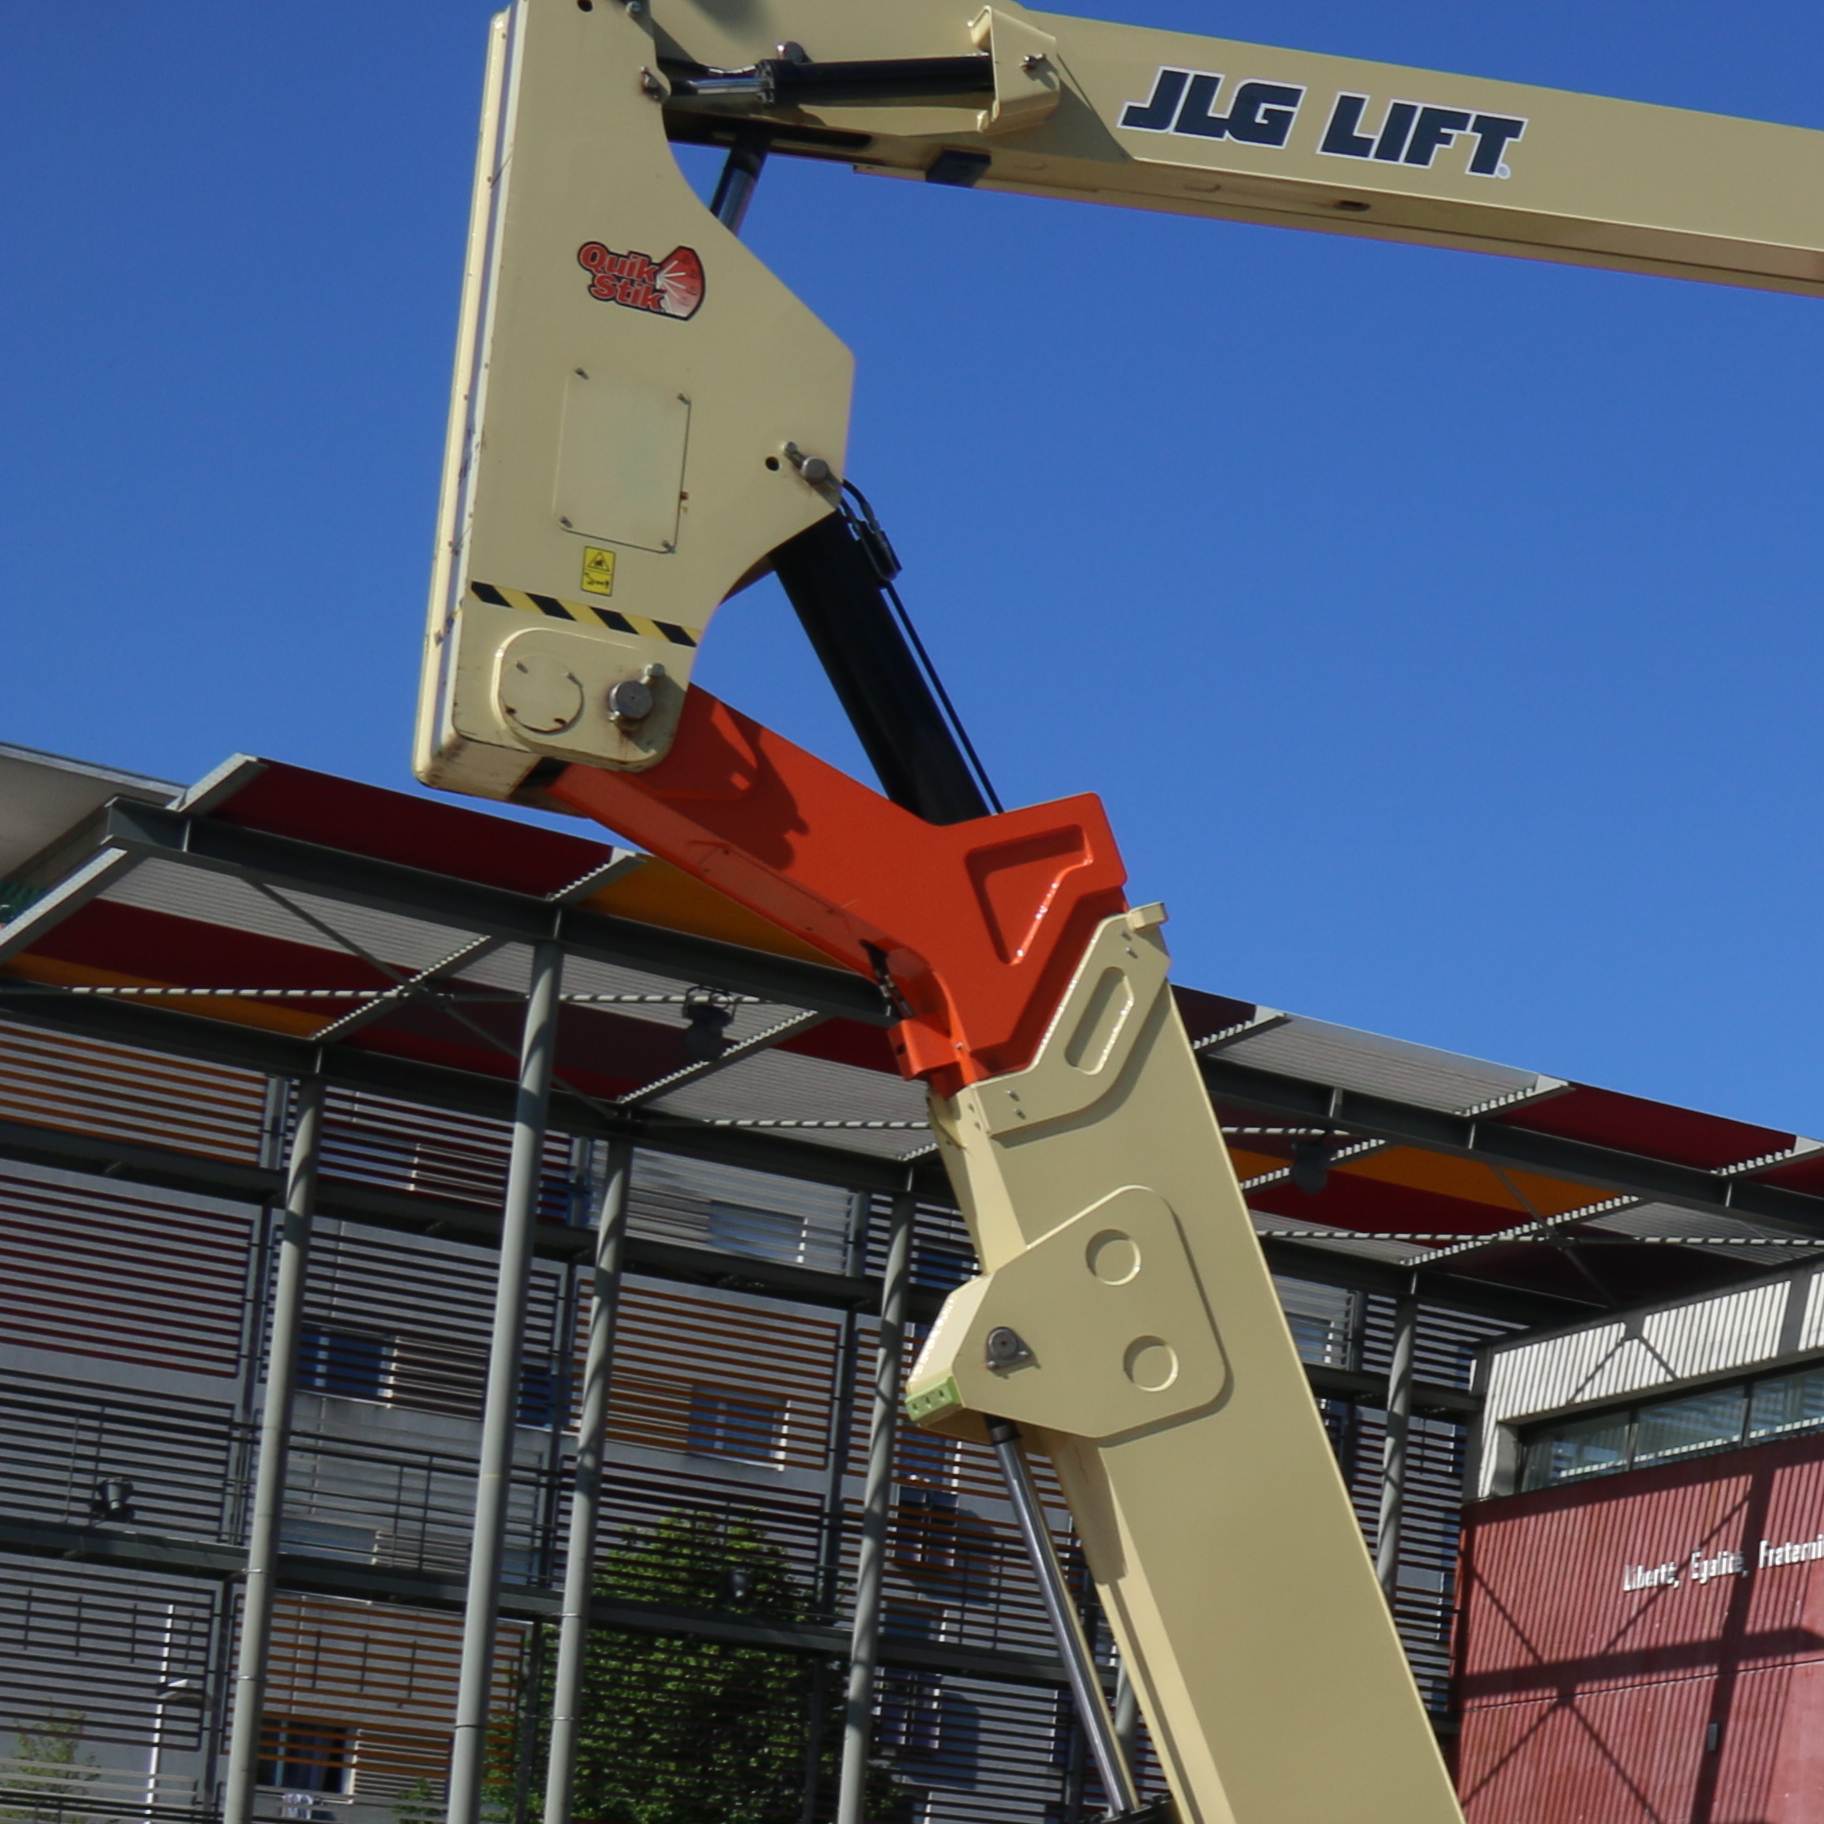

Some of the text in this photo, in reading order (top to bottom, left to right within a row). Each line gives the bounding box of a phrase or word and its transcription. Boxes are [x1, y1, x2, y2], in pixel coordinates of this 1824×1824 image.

[1118, 66, 1529, 178] JLG LIFT
[580, 243, 660, 284] Quik
[589, 273, 666, 312] Stik
